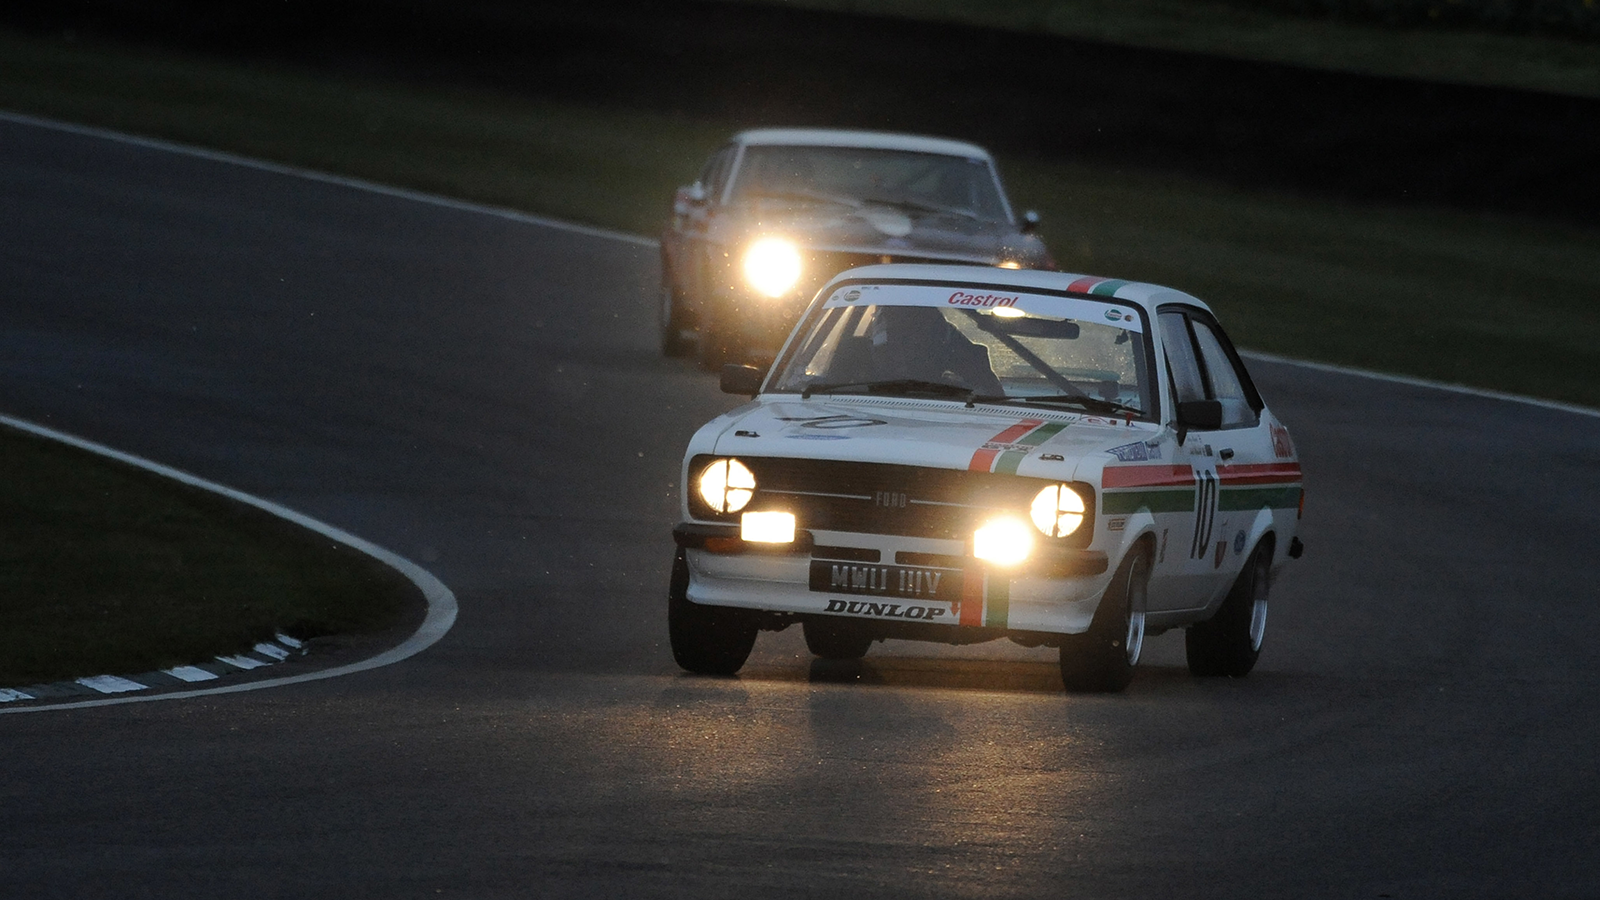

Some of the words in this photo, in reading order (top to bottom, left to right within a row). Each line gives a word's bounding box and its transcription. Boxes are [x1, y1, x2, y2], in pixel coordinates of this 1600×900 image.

[948, 291, 1019, 308] Castrol
[876, 491, 906, 508] FORD
[1190, 469, 1216, 560] 10
[823, 599, 946, 620] DUNLOP
